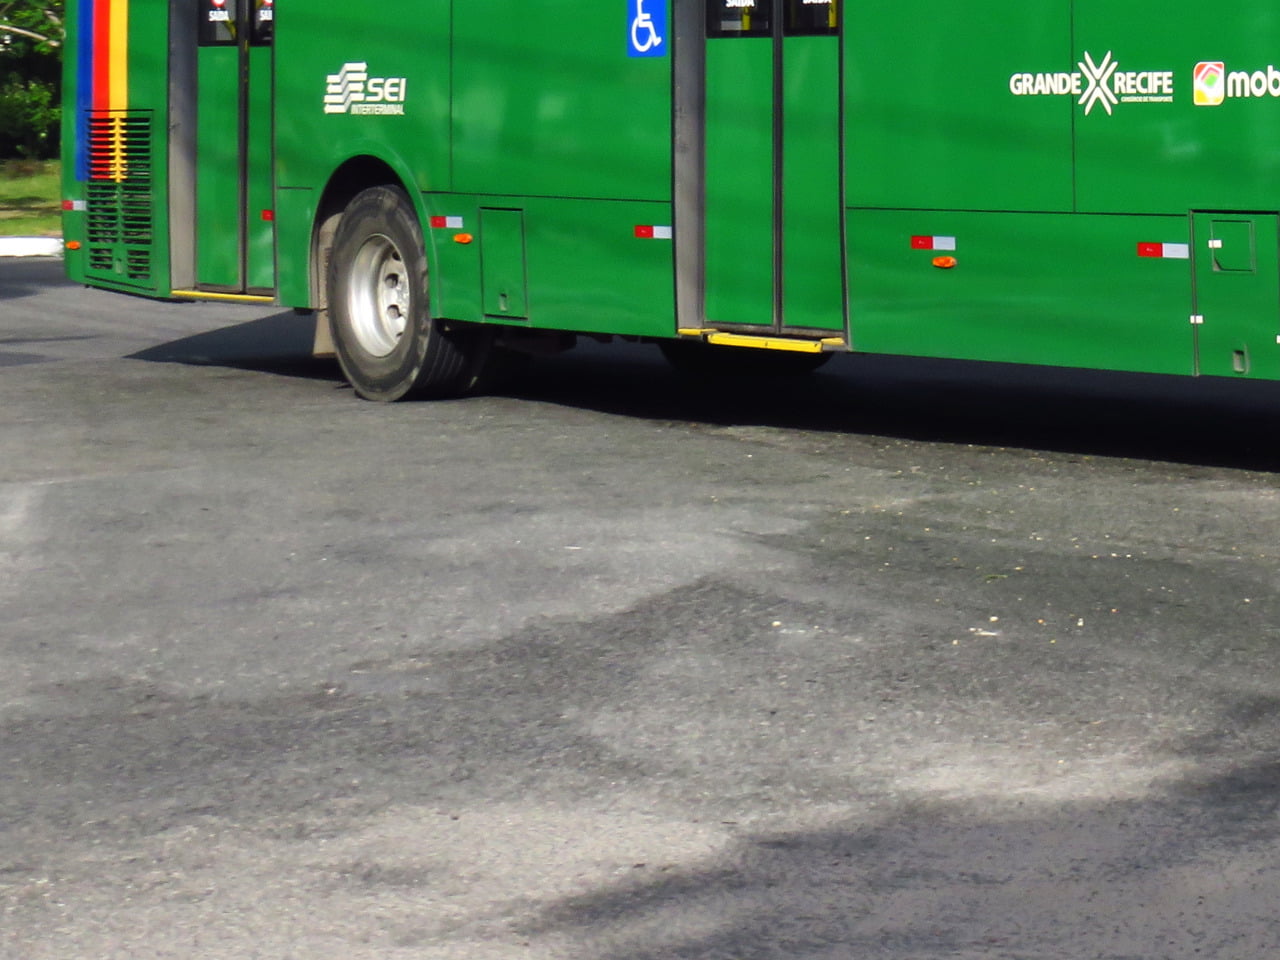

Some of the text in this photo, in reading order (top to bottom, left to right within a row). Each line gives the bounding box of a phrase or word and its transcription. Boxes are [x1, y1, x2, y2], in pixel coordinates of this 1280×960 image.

[365, 77, 407, 102] SEI
[1009, 71, 1174, 96] GRANDE RECIFE
